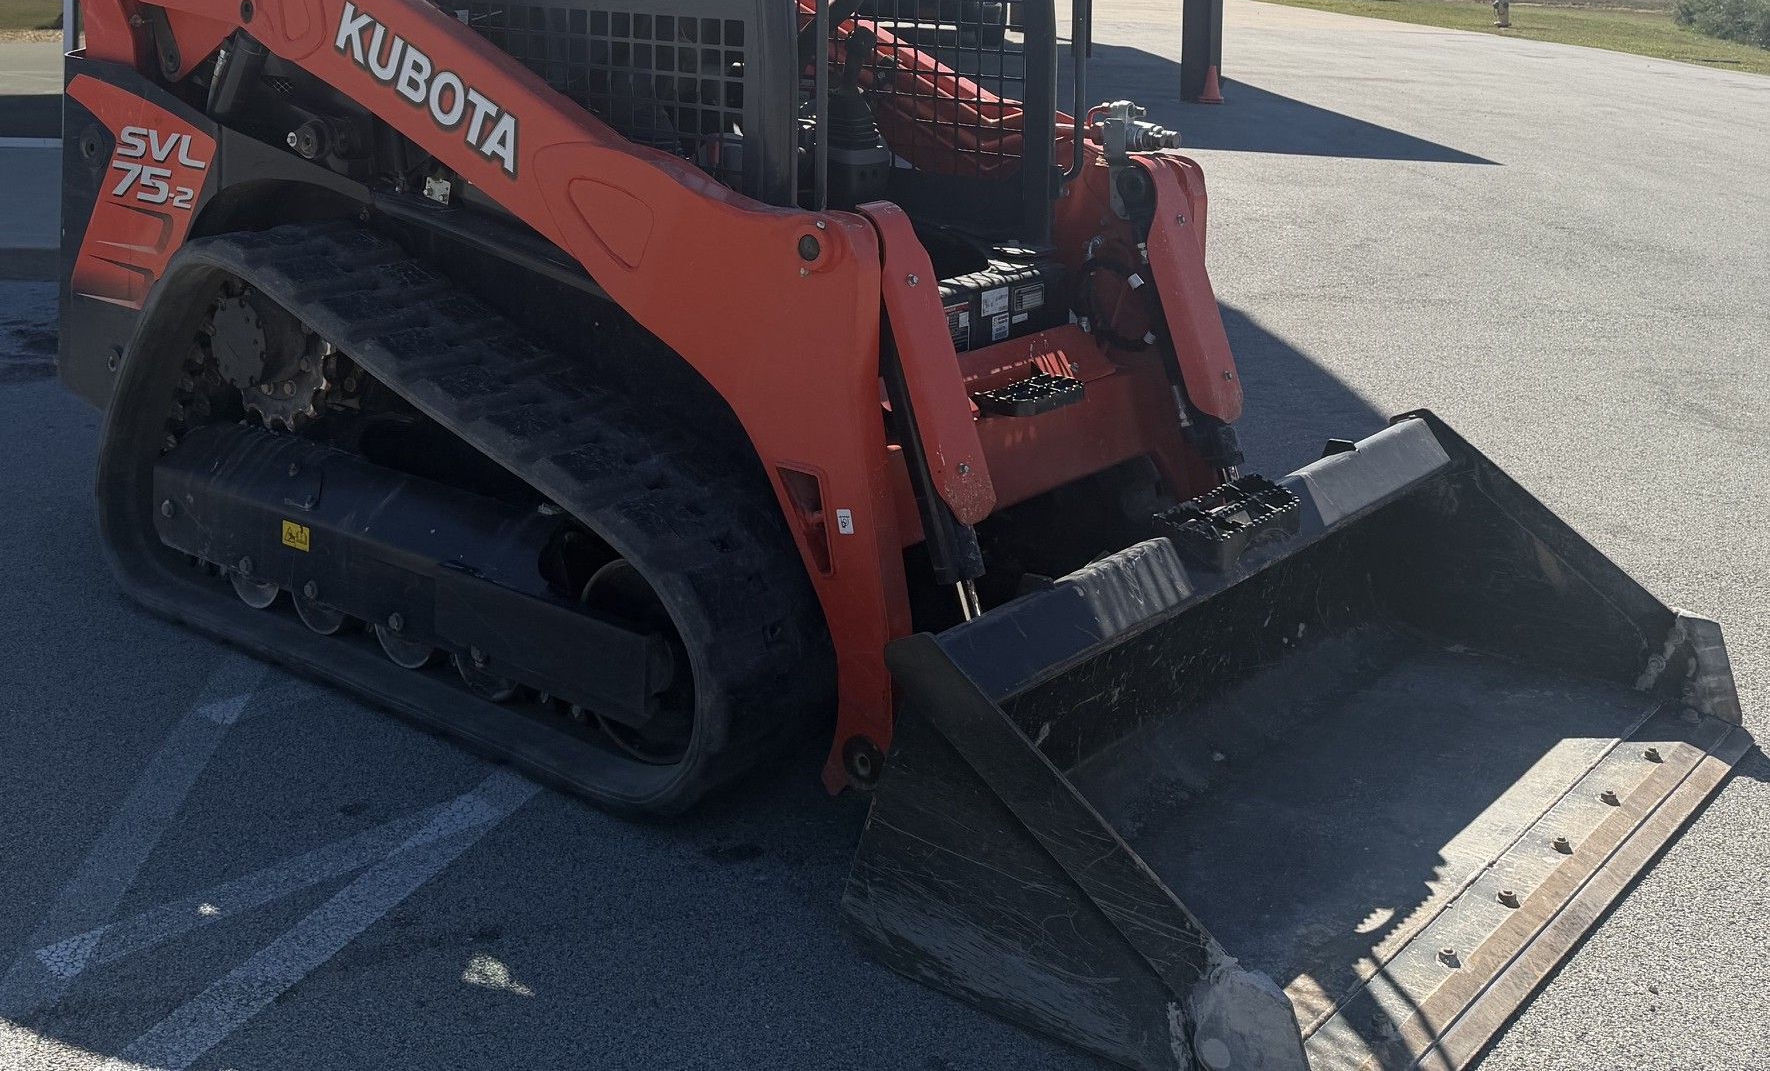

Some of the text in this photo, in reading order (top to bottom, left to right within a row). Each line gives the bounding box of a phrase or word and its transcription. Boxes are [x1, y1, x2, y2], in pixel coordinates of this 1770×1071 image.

[335, 1, 517, 174] KUBOTA
[117, 126, 206, 169] SVL
[112, 160, 194, 209] 75-2
